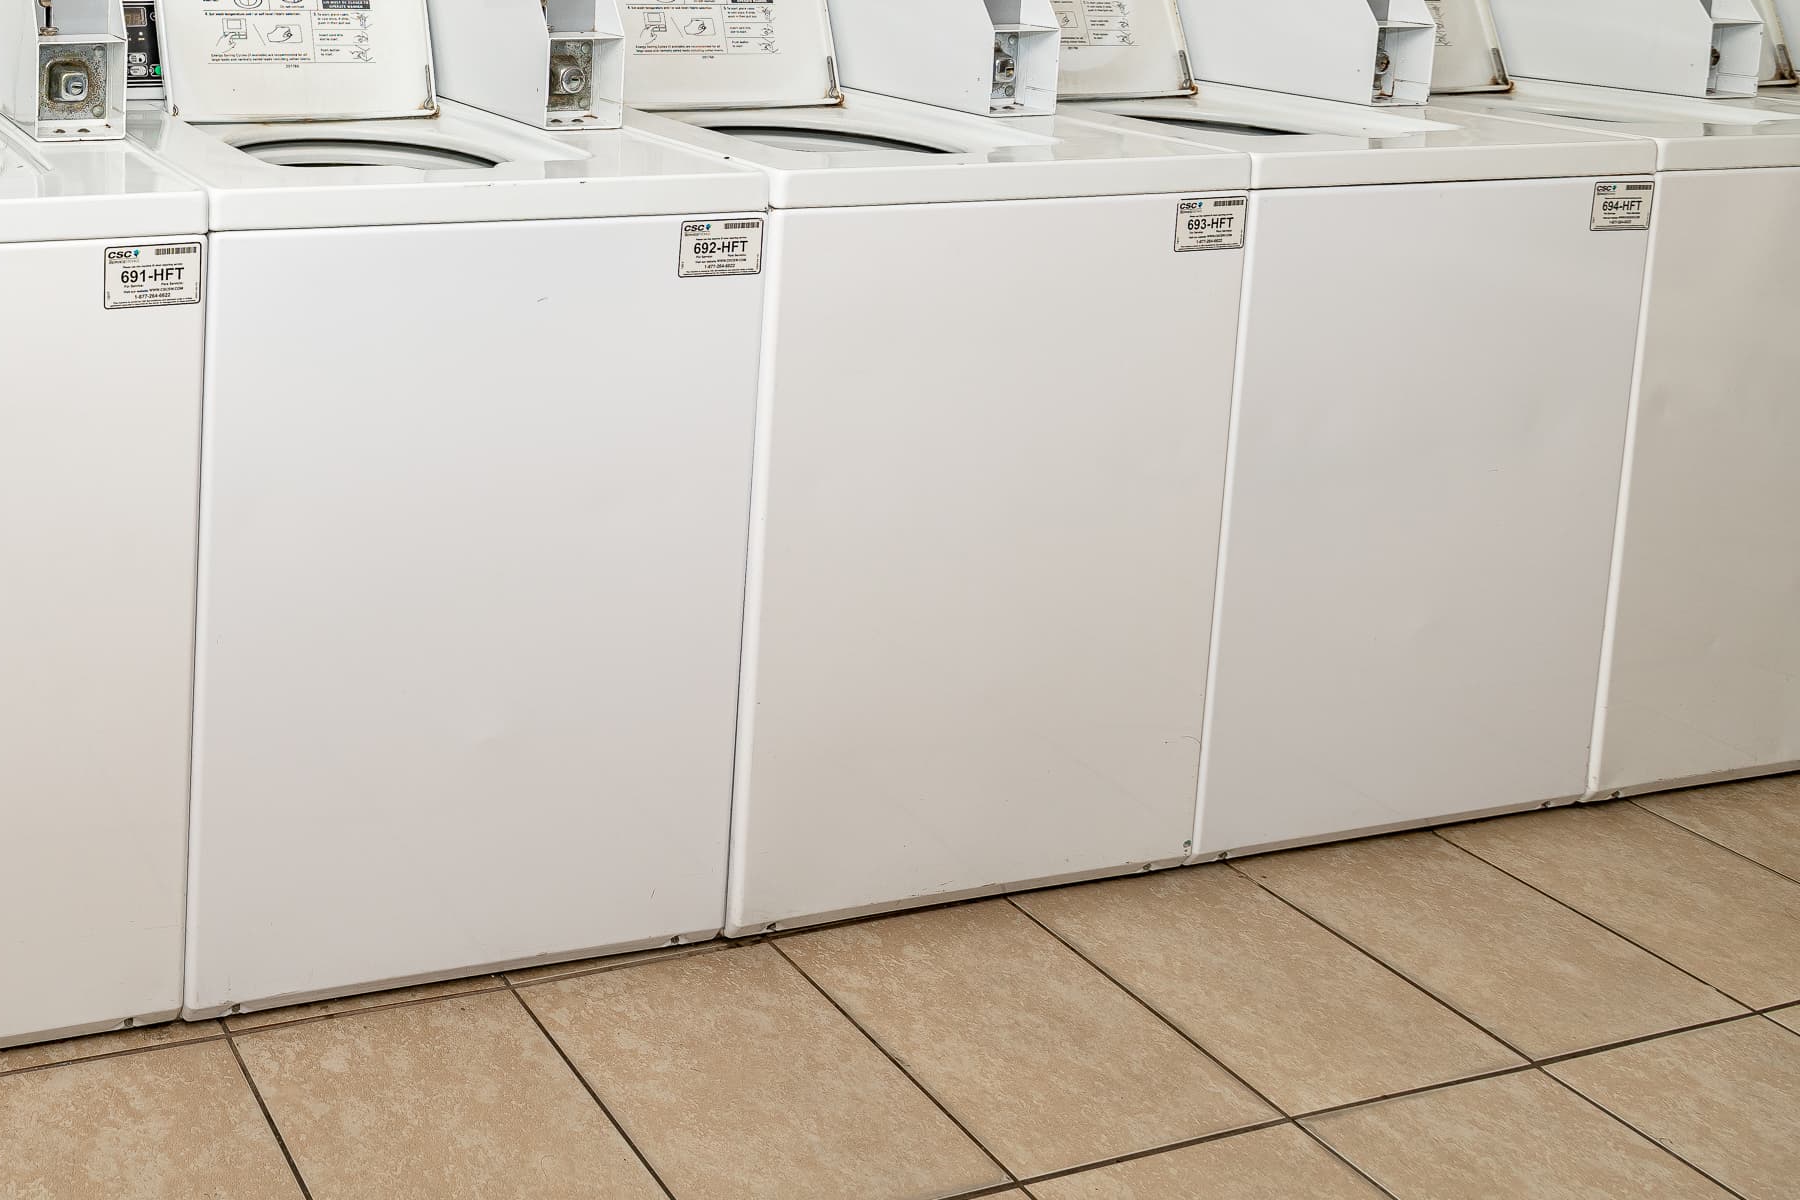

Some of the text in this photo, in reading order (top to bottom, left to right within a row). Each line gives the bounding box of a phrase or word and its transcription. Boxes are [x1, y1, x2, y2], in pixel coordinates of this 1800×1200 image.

[1602, 201, 1643, 212] 694-HFT
[684, 224, 705, 232] CSC
[1187, 217, 1235, 231] 693-HFT
[694, 241, 749, 255] 692-HFT
[108, 250, 133, 259] CSC
[121, 267, 185, 284] 691-HFT
